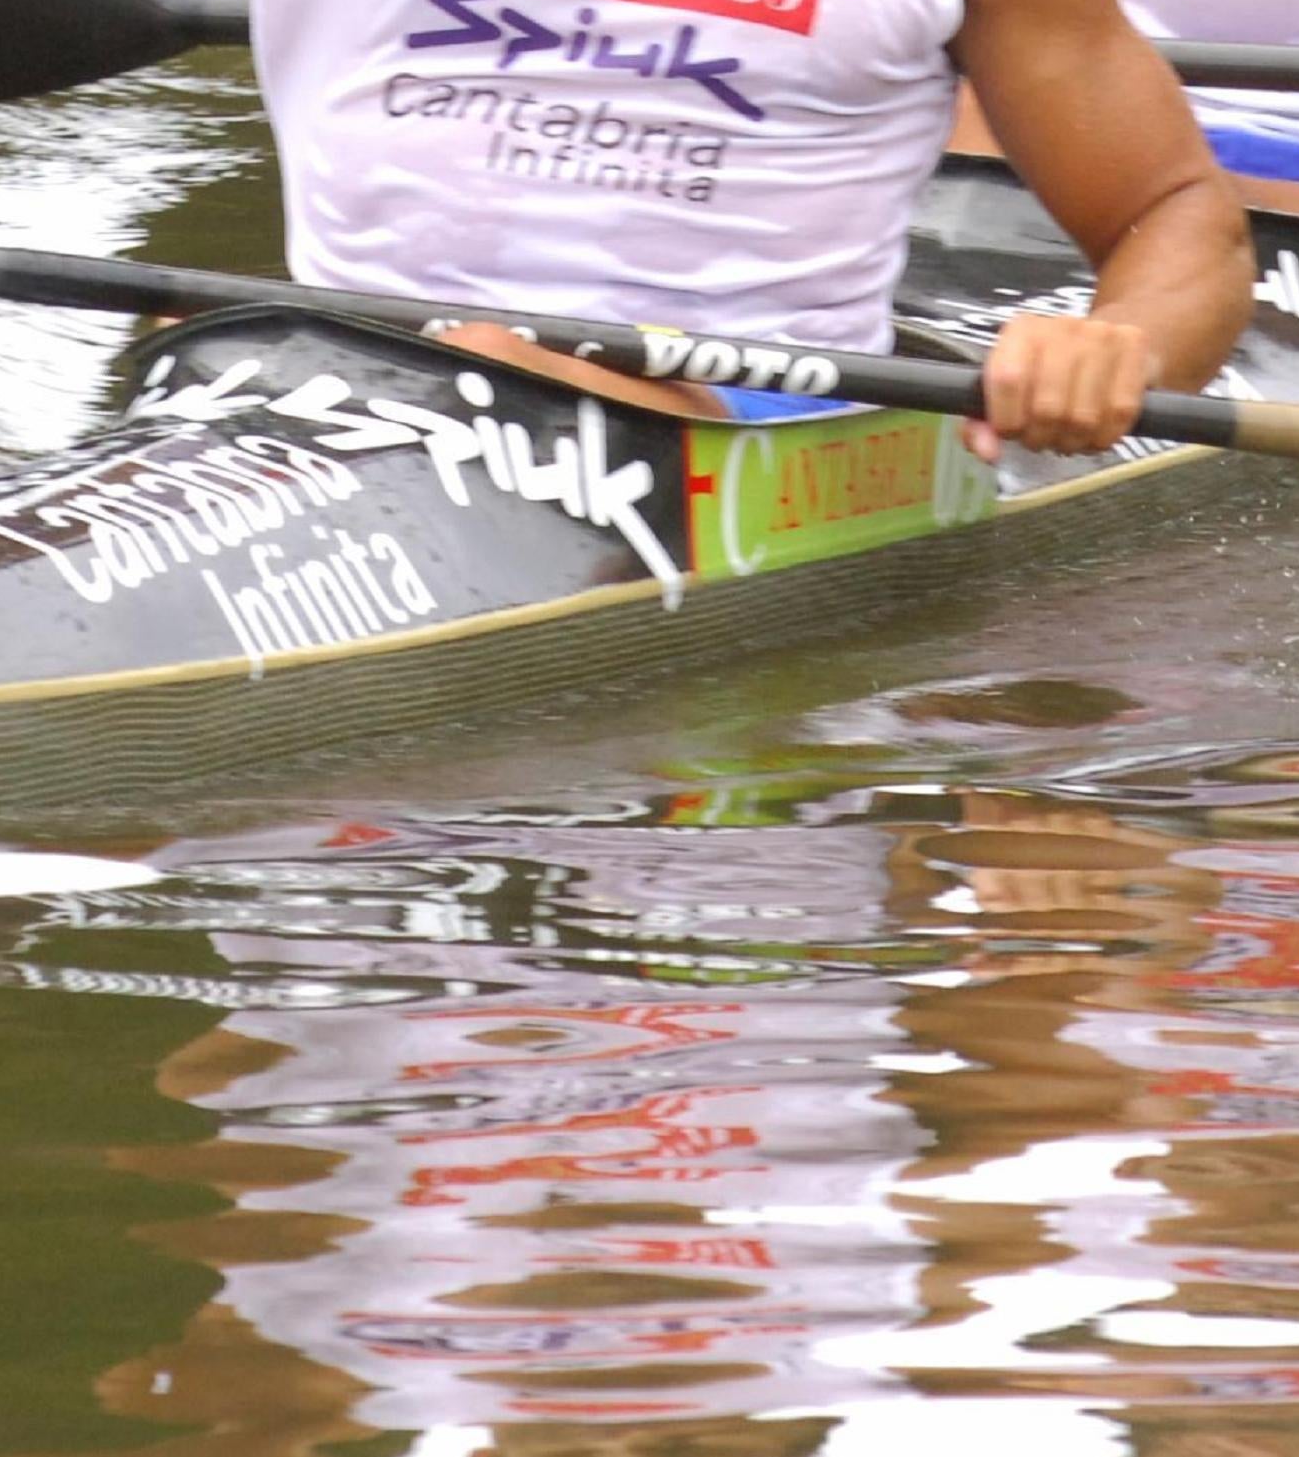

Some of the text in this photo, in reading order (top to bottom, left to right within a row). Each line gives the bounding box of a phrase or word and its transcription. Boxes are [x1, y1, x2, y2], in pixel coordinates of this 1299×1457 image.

[383, 72, 732, 170] Cantabria
[486, 132, 719, 204] Infinita
[643, 332, 840, 396] VOTO
[264, 372, 685, 612] Spiuk
[200, 524, 439, 681] Infinita
